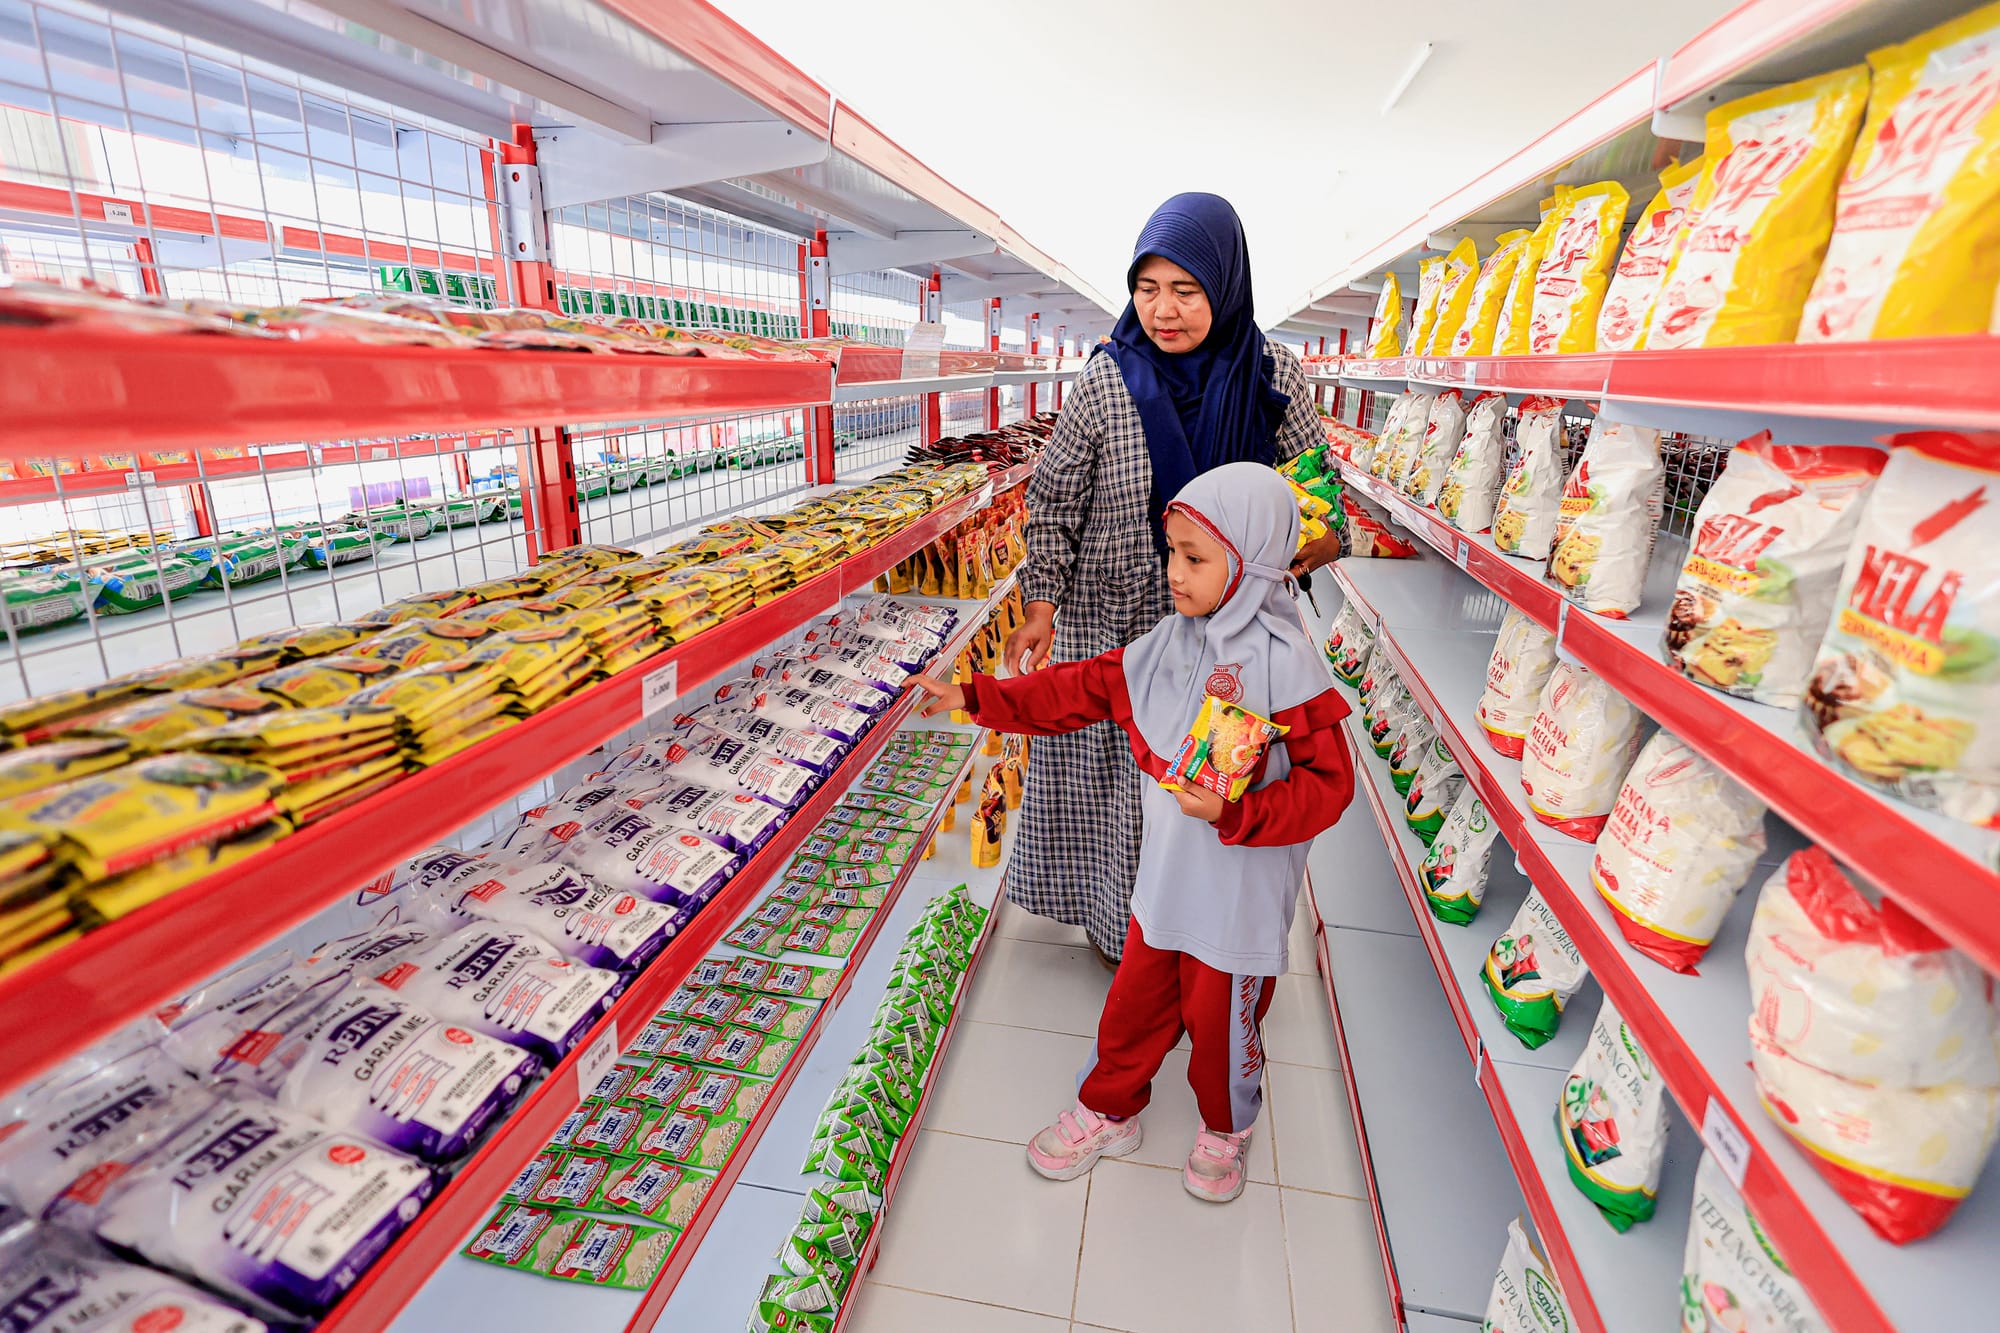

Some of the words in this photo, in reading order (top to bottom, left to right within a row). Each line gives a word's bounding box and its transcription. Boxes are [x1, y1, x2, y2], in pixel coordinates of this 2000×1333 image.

[1849, 544, 1965, 645] MILA
[1533, 711, 1569, 748] ENCANA
[709, 738, 745, 768] REFIN
[667, 784, 708, 814] REFIN
[1620, 783, 1671, 833] ENCANA
[421, 852, 477, 889] REFIN
[549, 866, 567, 882] Salt
[435, 944, 471, 971] Refined
[446, 932, 525, 990] REFINA
[473, 960, 519, 1002] GARAM
[323, 1001, 410, 1067] REFINA
[354, 1028, 406, 1081] GARAM
[633, 1167, 662, 1200] REFINA
[582, 1230, 611, 1267] REFINA
[1695, 1193, 1762, 1279] TEPUNG
[1496, 1268, 1532, 1328] TEPUNG
[1532, 1280, 1561, 1327] Sania
